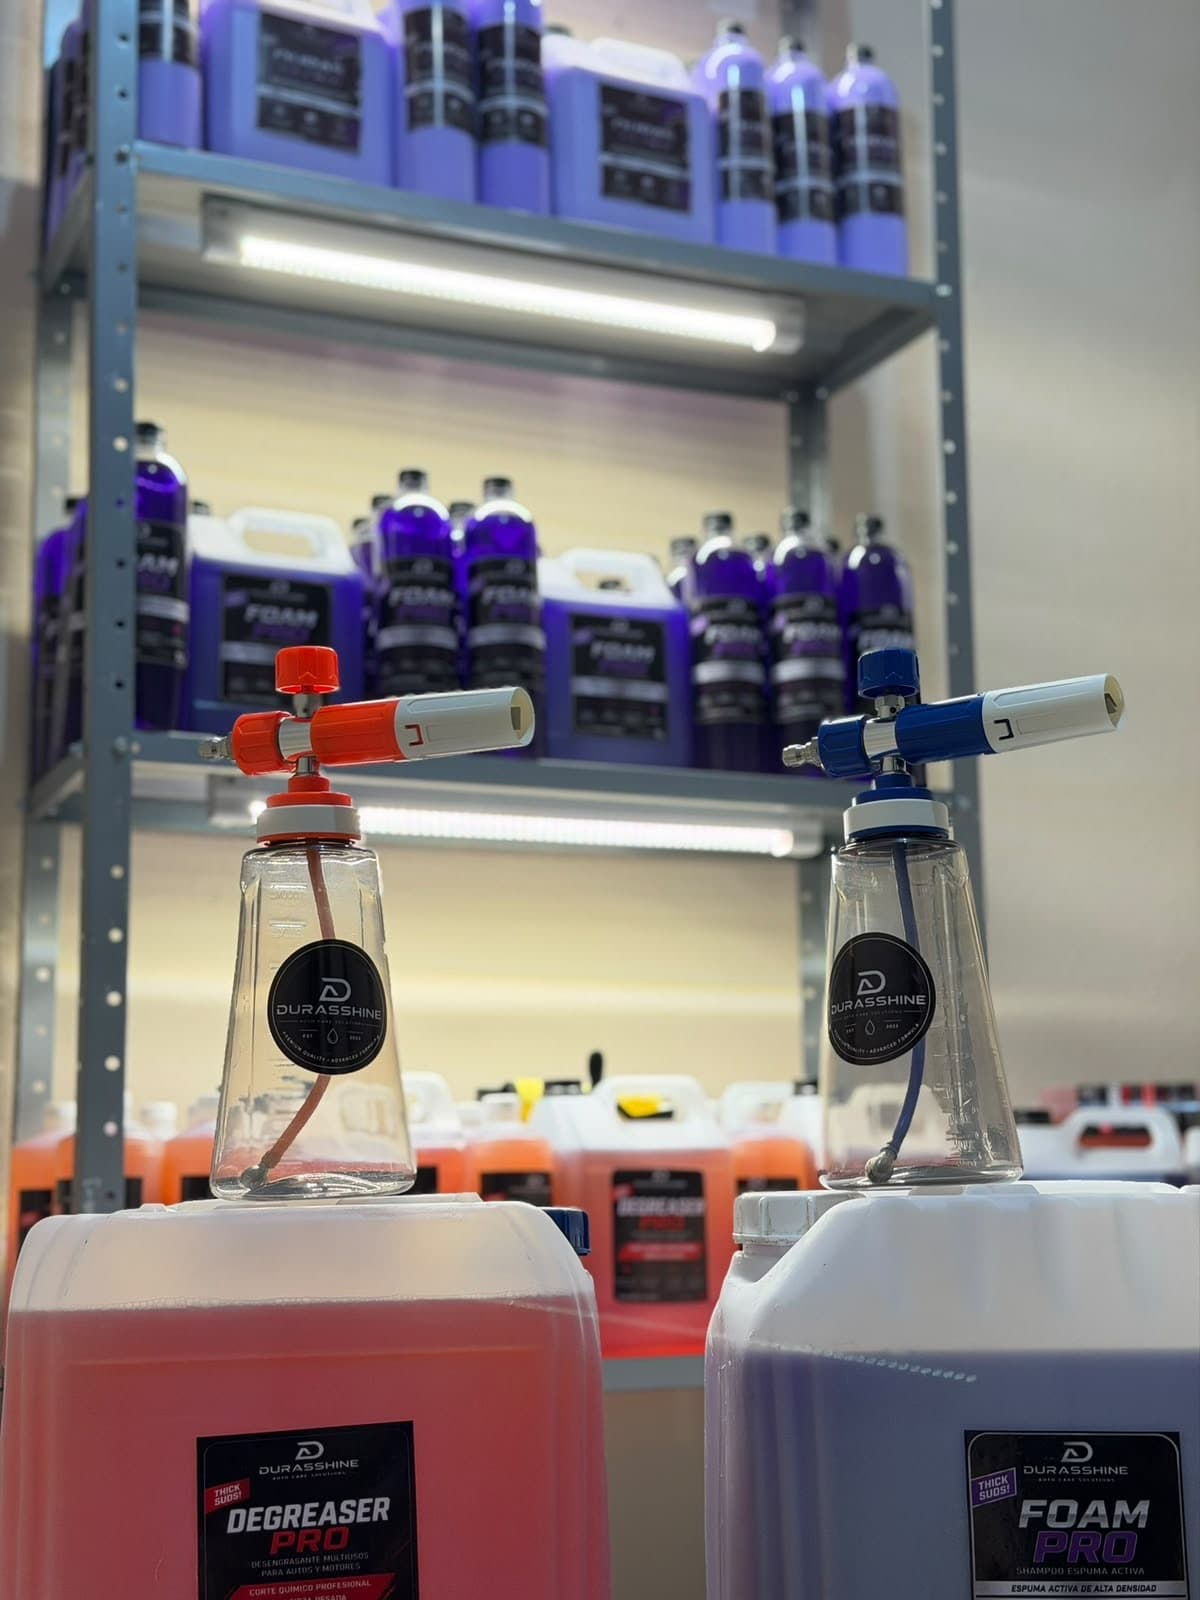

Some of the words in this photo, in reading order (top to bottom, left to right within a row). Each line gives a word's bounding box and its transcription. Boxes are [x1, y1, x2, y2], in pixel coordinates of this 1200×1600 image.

[244, 603, 319, 630] FOAM
[276, 1004, 382, 1020] DURASSHINE
[831, 994, 927, 1015] DURASSHINE
[258, 1459, 360, 1475] DURASSHINE
[1023, 1465, 1129, 1475] DURASSHINE
[213, 1483, 241, 1497] THICK
[978, 1474, 1009, 1491] THICK
[214, 1490, 242, 1506] SUDS!
[979, 1483, 1010, 1501] SUDS!
[226, 1497, 391, 1534] DEGREASER
[1018, 1499, 1150, 1529] FOAM
[269, 1526, 349, 1556] PRO
[1032, 1530, 1138, 1564] PRO
[251, 1555, 320, 1569] DESENGRASANTE
[323, 1552, 369, 1563] MULTIUSOS
[261, 1568, 284, 1577] PARA
[285, 1566, 313, 1576] AUTOS
[314, 1565, 321, 1573] Y
[1016, 1567, 1064, 1576] SHAMPOO
[1067, 1567, 1109, 1576] ESPUMA
[1111, 1567, 1145, 1576] ACTIVA
[249, 1587, 276, 1597] CORTE
[315, 1579, 372, 1591] PROFESIONAL
[1011, 1584, 1046, 1593] ESPUMA
[1048, 1584, 1078, 1593] ACTIVA
[1081, 1584, 1092, 1593] DE
[1093, 1584, 1114, 1593] ALTA
[1116, 1584, 1157, 1593] DENSIDAD
